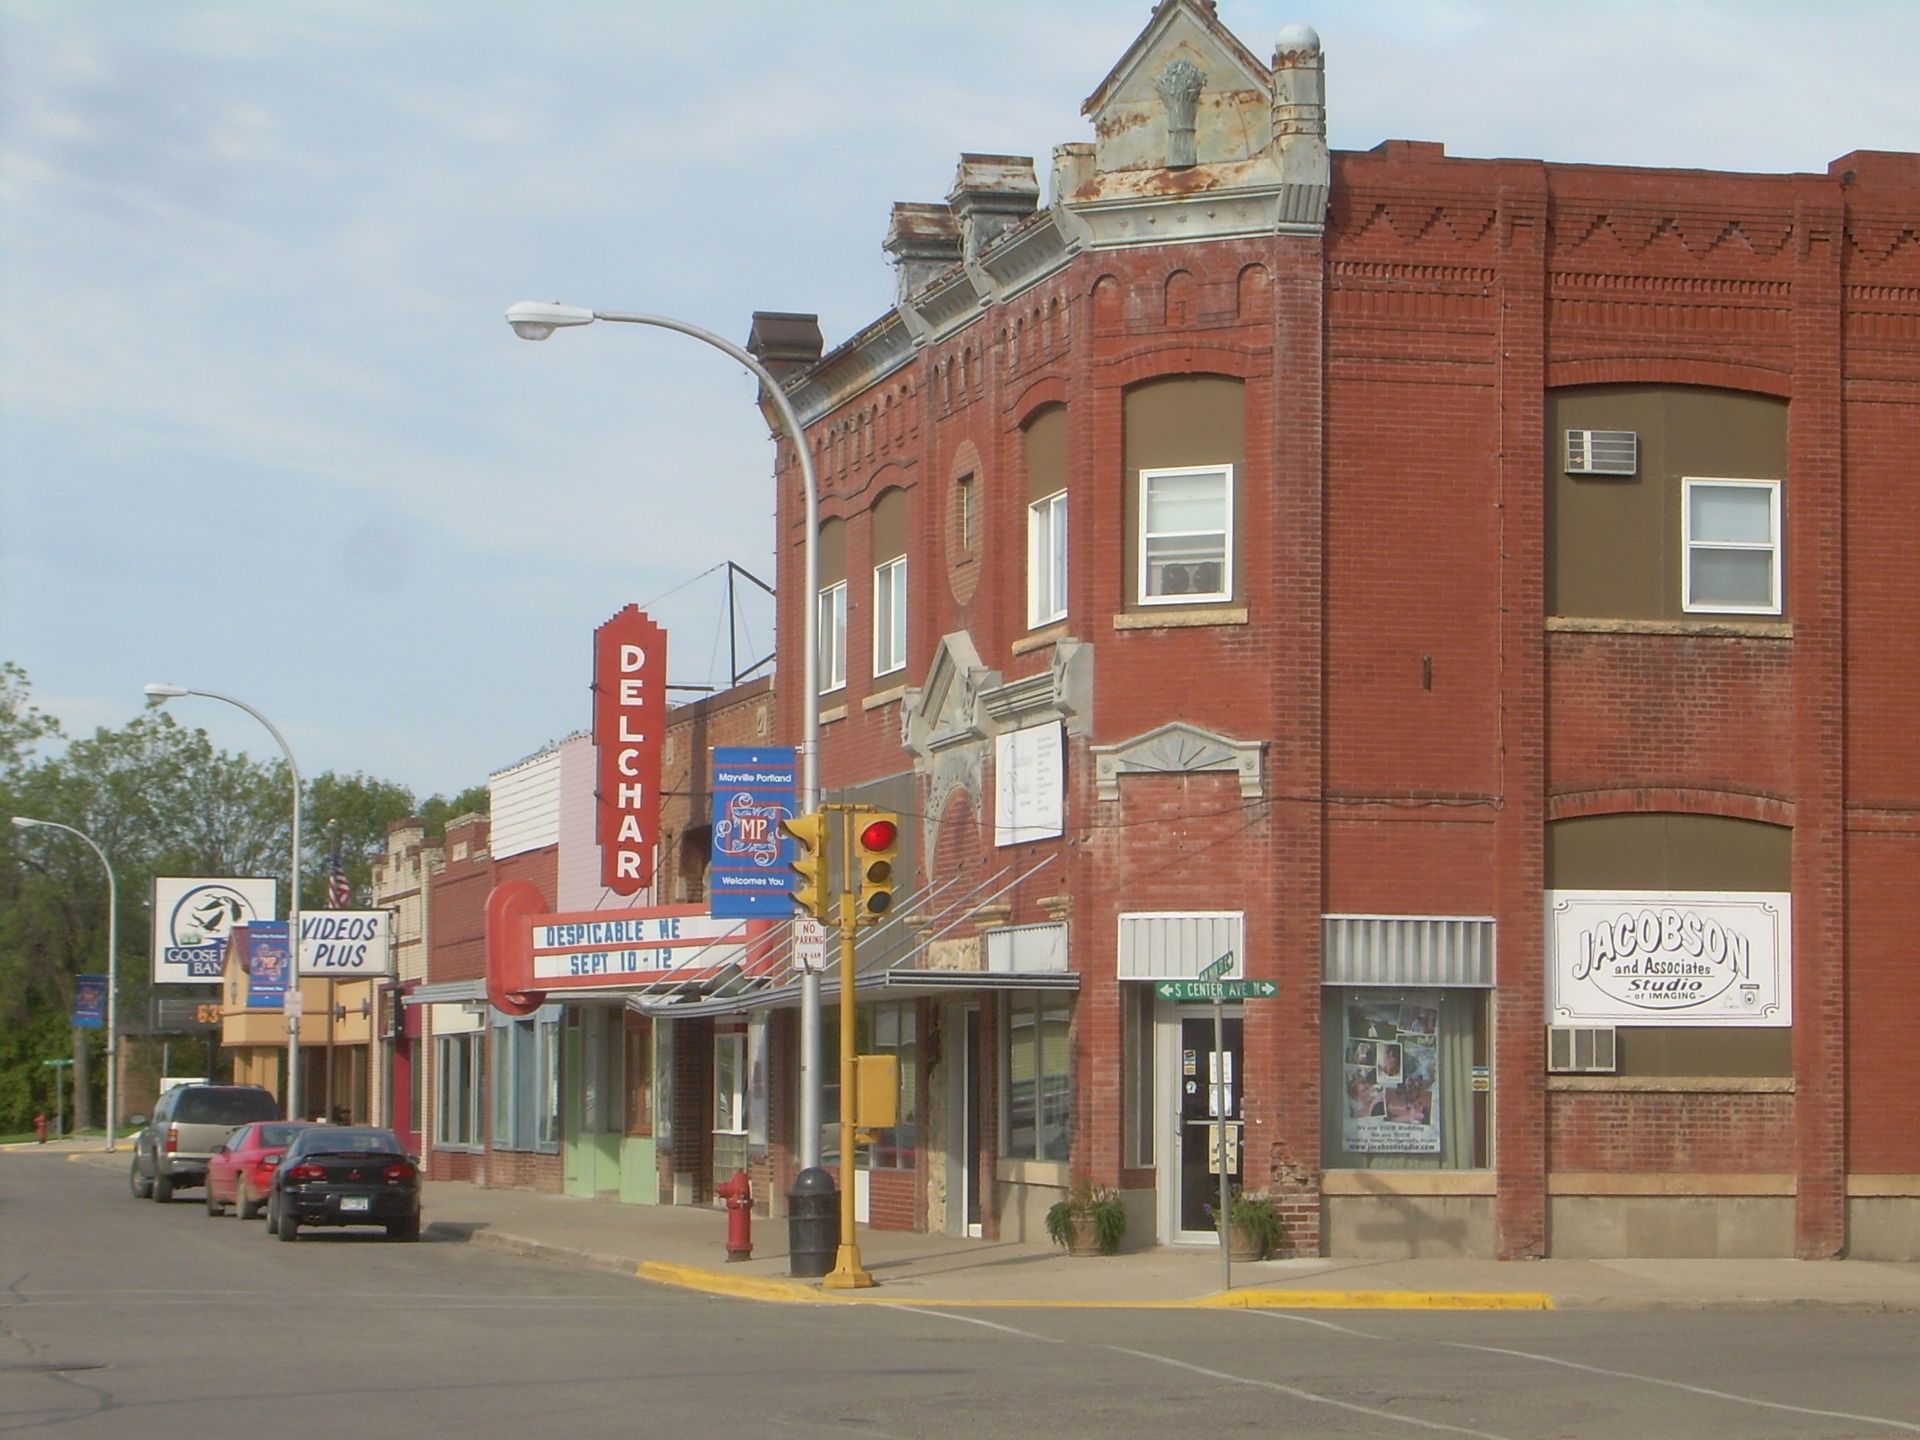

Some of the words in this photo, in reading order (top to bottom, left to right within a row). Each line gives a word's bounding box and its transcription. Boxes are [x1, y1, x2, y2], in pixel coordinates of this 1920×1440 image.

[616, 644, 646, 880] DELCHAR
[718, 771, 755, 783] Mayville
[756, 773, 792, 783] Portland
[740, 818, 767, 840] MP
[721, 876, 766, 886] Welcomes
[768, 877, 785, 886] You
[301, 917, 379, 941] VIDEOS
[546, 920, 644, 947] DESPICABLE
[658, 918, 682, 939] ME
[802, 924, 816, 934] NO
[795, 935, 823, 944] PARKING
[1571, 908, 1750, 980] JACOBSON
[167, 948, 218, 962] GOOSE
[313, 943, 368, 968] PLUS
[194, 962, 222, 975] BAN
[571, 953, 609, 976] SEPT
[1614, 959, 1639, 975] and
[1644, 956, 1711, 975] Associates
[1174, 983, 1182, 997] S
[1187, 983, 1223, 997] CENTER
[1229, 982, 1248, 996] AVE
[1253, 981, 1260, 996] N
[1628, 978, 1703, 992] Studio
[1634, 992, 1645, 1000] of
[1649, 991, 1696, 1000] IMAGING
